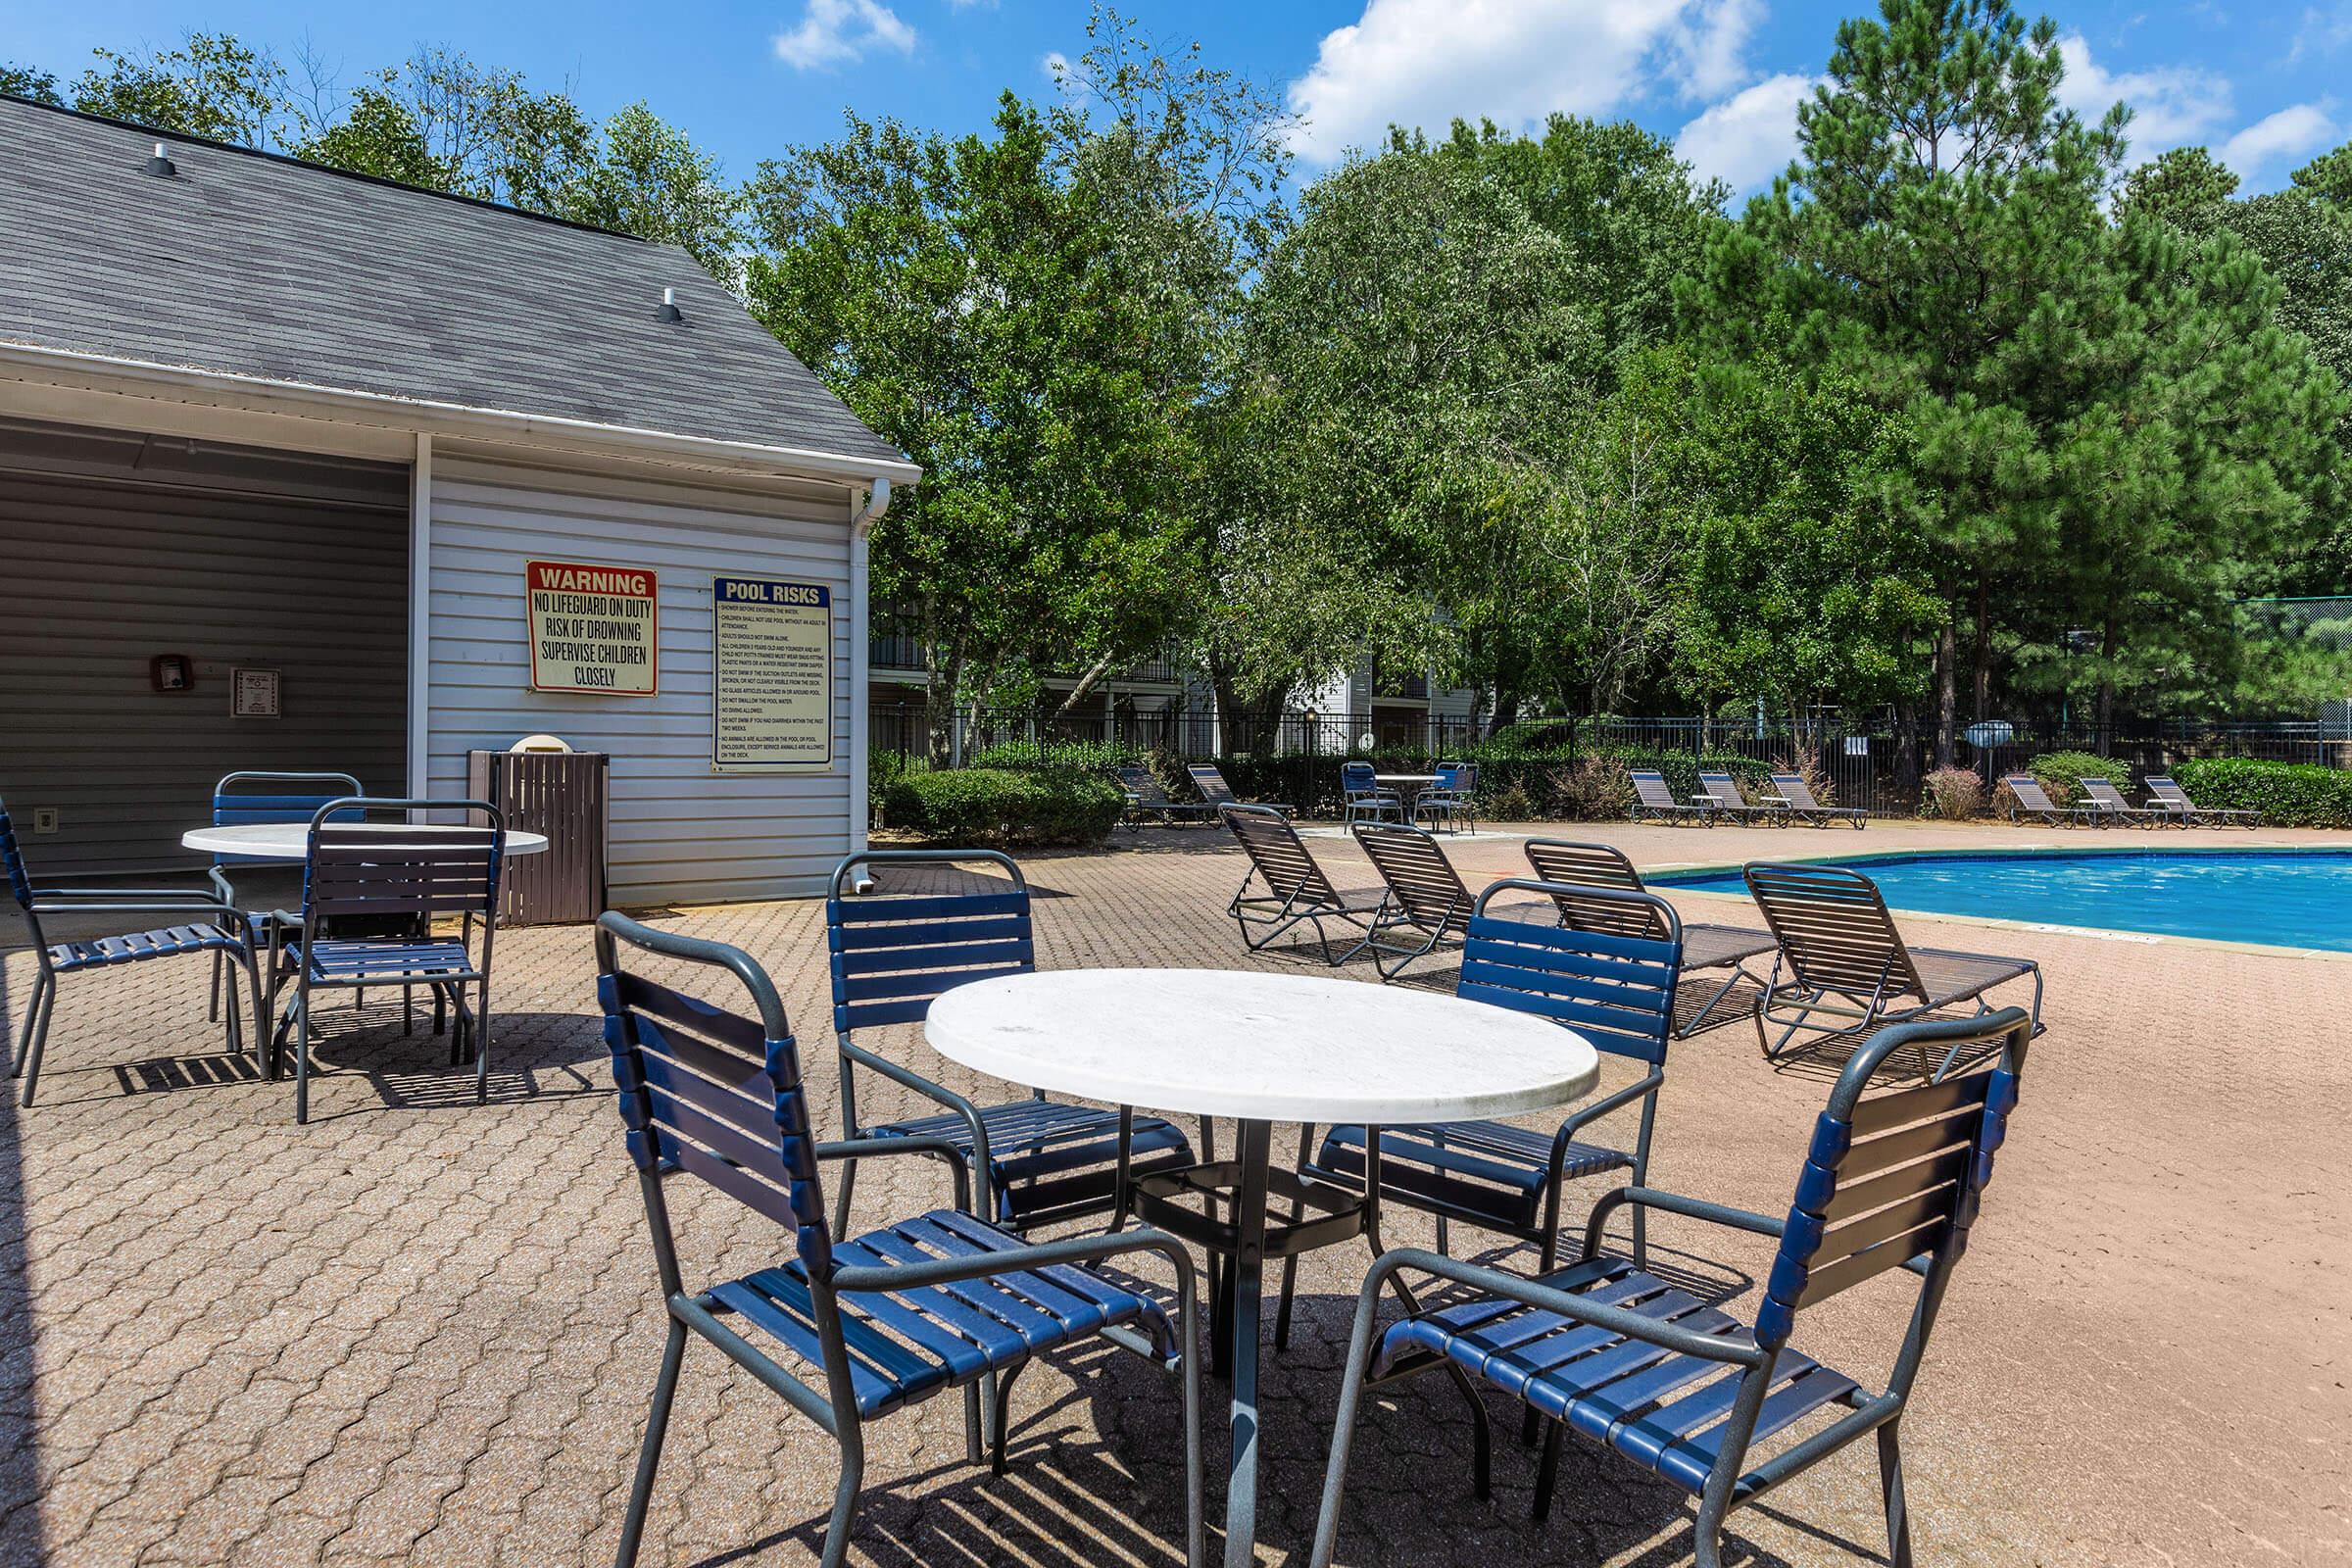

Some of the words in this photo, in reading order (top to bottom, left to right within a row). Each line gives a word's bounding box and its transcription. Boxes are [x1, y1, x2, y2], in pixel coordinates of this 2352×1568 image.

[539, 568, 646, 595] WARNING
[726, 582, 768, 601] POOL
[773, 586, 819, 604] RISKS
[535, 593, 549, 612] NO
[552, 594, 606, 615] LIFEGUARD
[610, 598, 623, 616] ON
[626, 599, 651, 618] DUTY
[547, 618, 569, 637] RISK
[572, 619, 584, 638] OF
[588, 620, 641, 641] DROWNING
[542, 641, 595, 662] SUPERVISE
[598, 645, 646, 664] CHILDREN
[575, 666, 615, 687] CLOSELY
